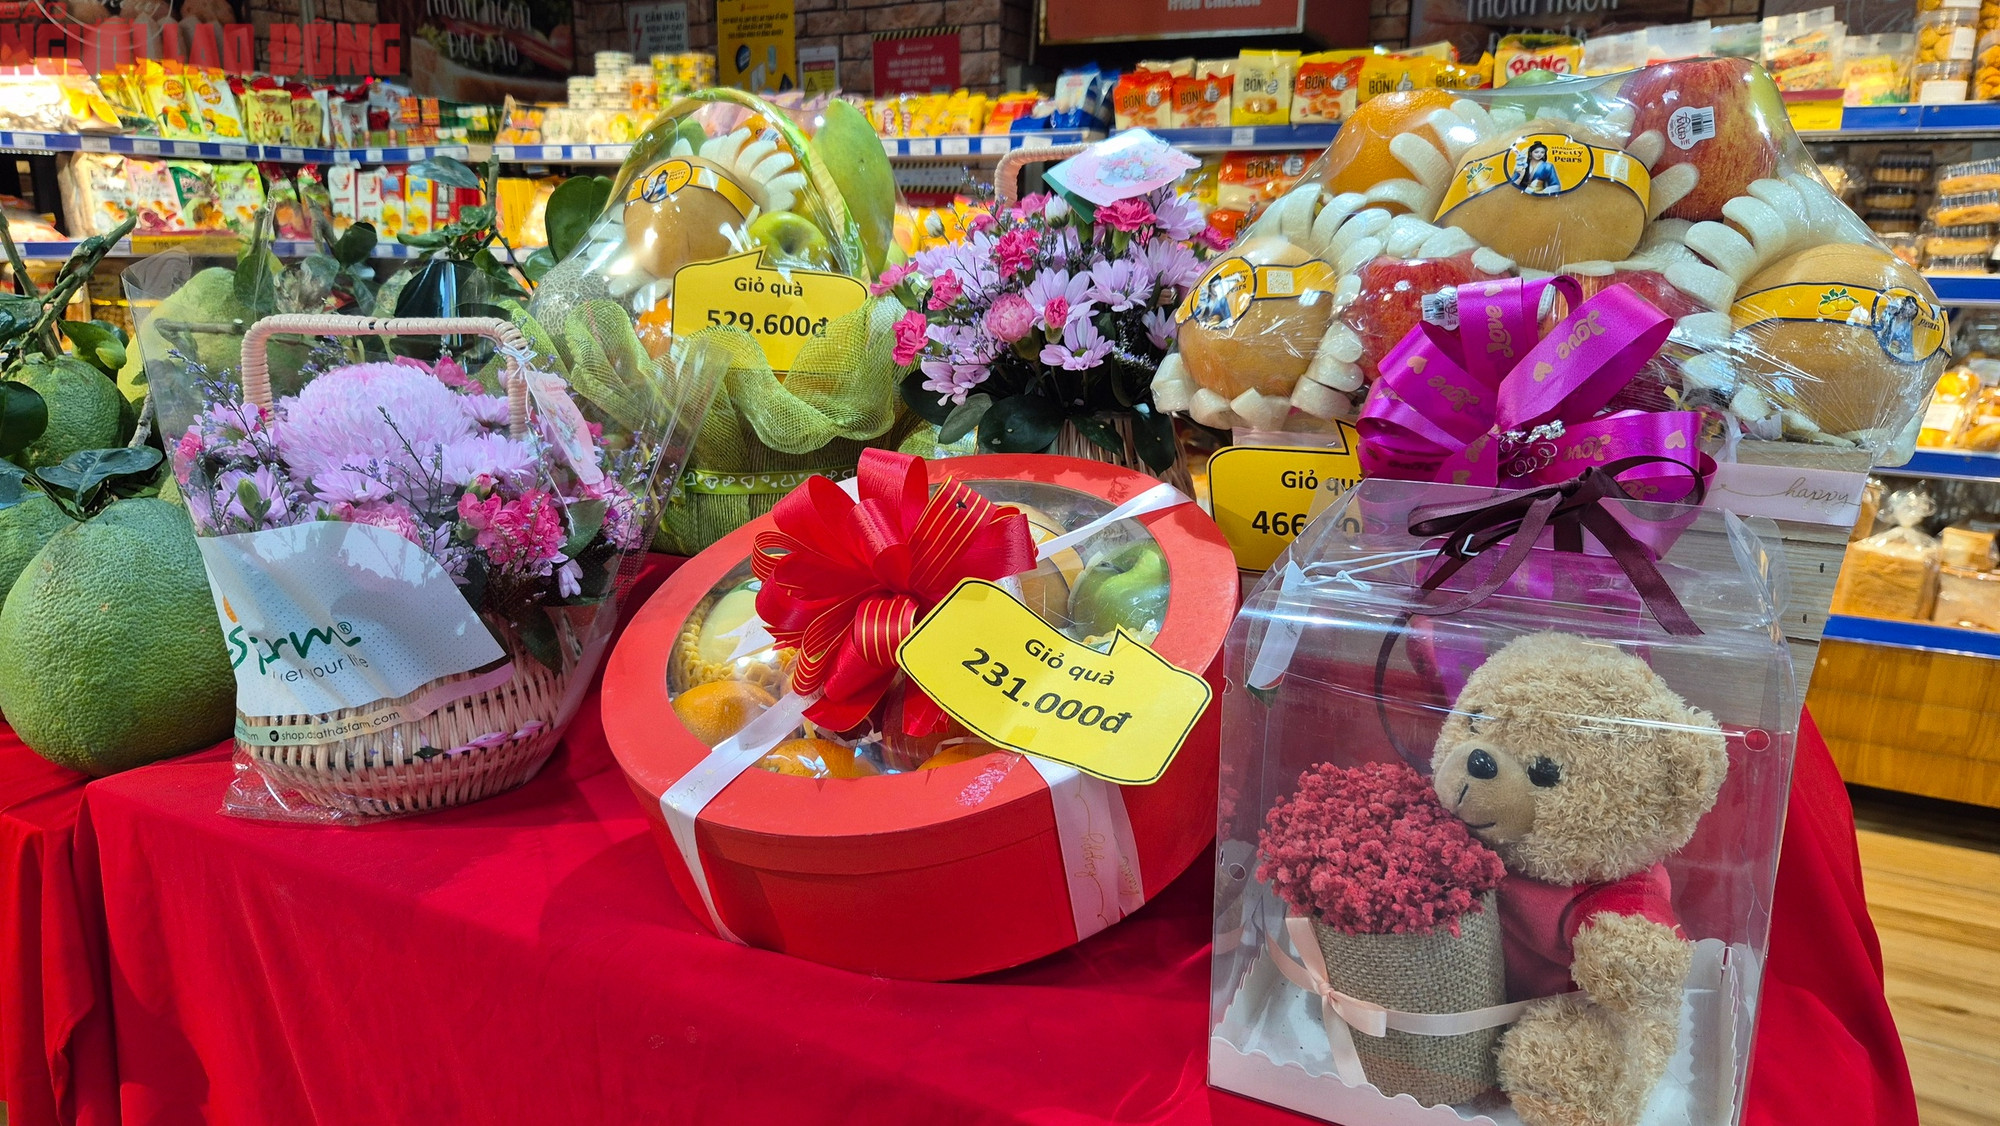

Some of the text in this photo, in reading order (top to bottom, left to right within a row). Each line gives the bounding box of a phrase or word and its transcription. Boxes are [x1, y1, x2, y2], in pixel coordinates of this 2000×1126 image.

[734, 276, 804, 298] Giỏ quà
[1280, 469, 1318, 490] Giỏ
[1024, 637, 1116, 686] Giỏ quà
[961, 646, 1133, 735] 231.000đ
